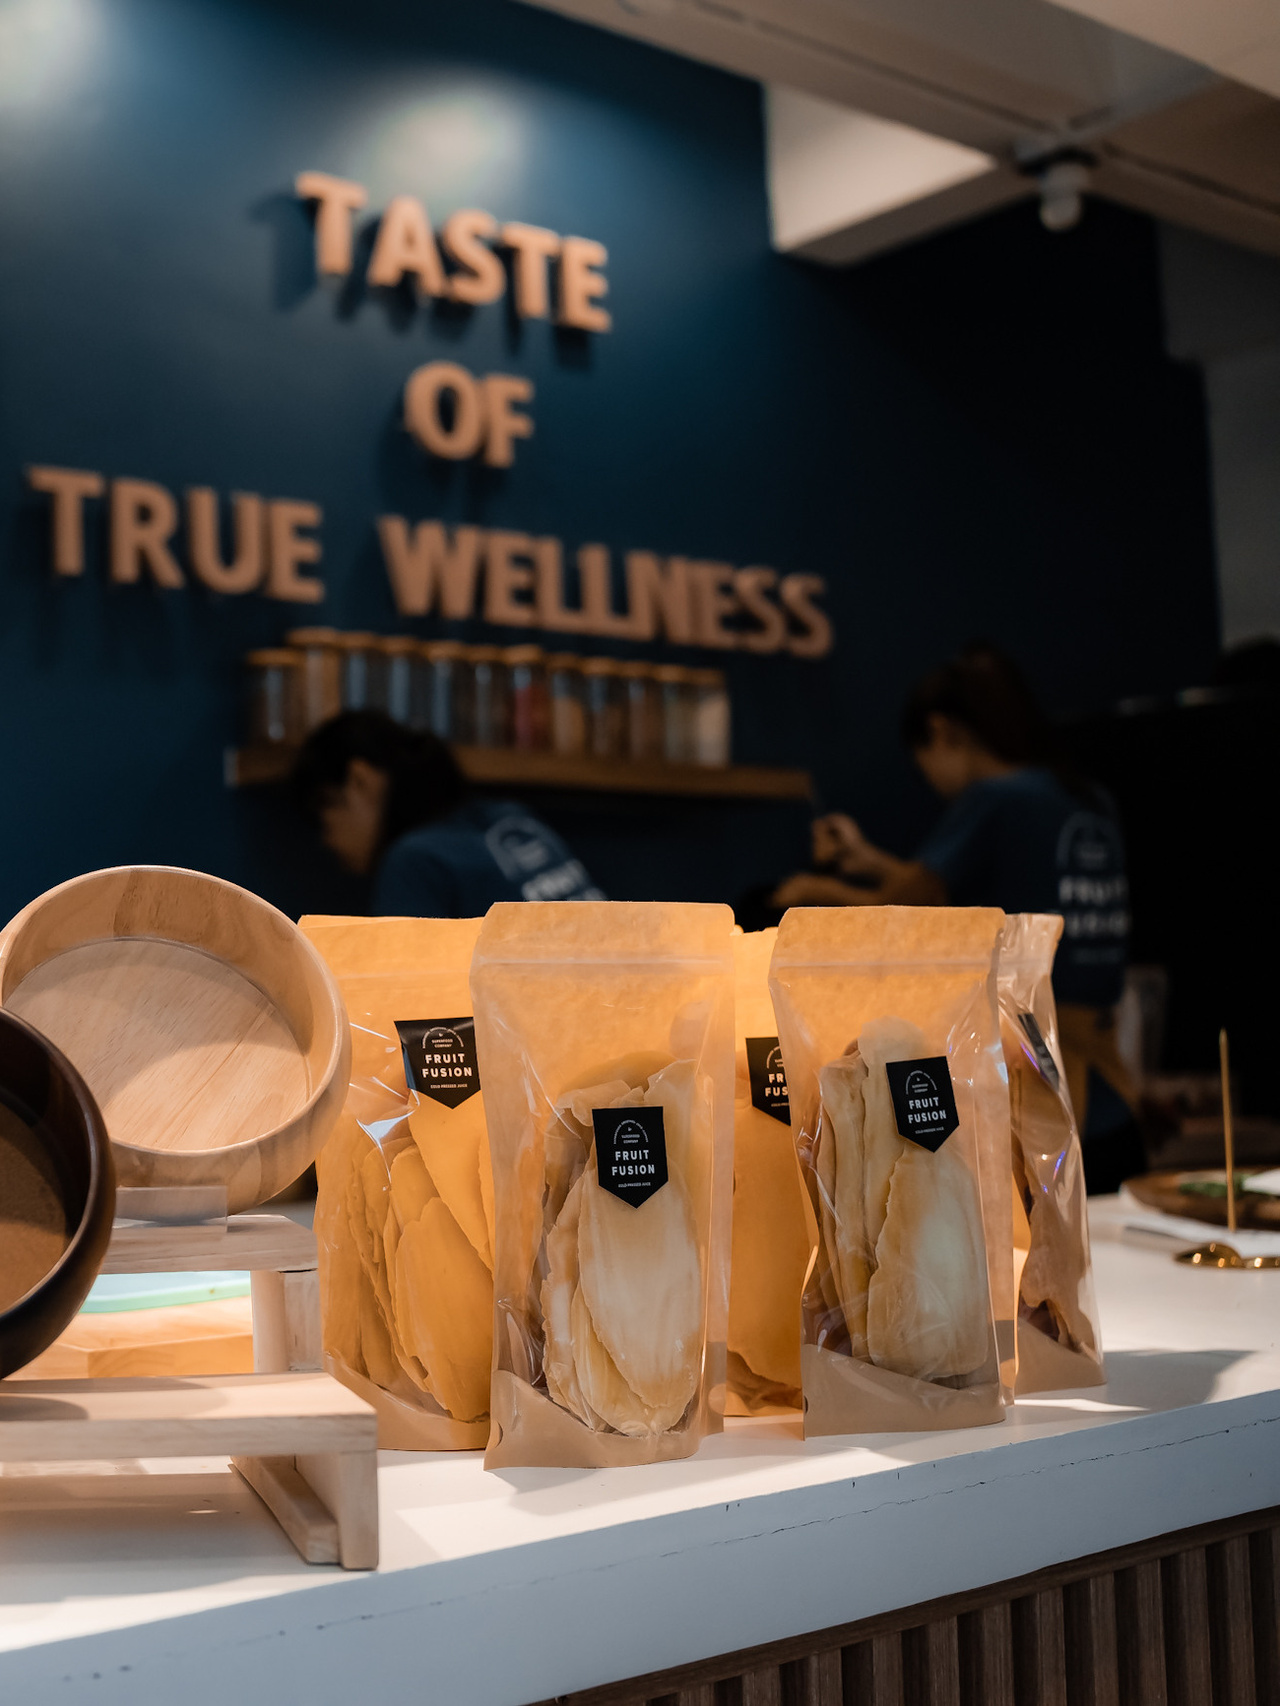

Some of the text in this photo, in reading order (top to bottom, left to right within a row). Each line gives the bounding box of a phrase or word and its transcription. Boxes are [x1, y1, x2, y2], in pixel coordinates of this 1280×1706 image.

[295, 171, 612, 333] TASTE
[404, 360, 534, 468] OF
[28, 466, 834, 659] TRUE WELLNESS
[425, 1053, 466, 1064] FRUIT
[422, 1067, 473, 1078] FUSION
[764, 1086, 788, 1097] FUS
[908, 1096, 940, 1110] FRUIT
[907, 1109, 947, 1124] FUSION
[615, 1149, 650, 1161] FRUIT
[611, 1164, 655, 1176] FUSION
